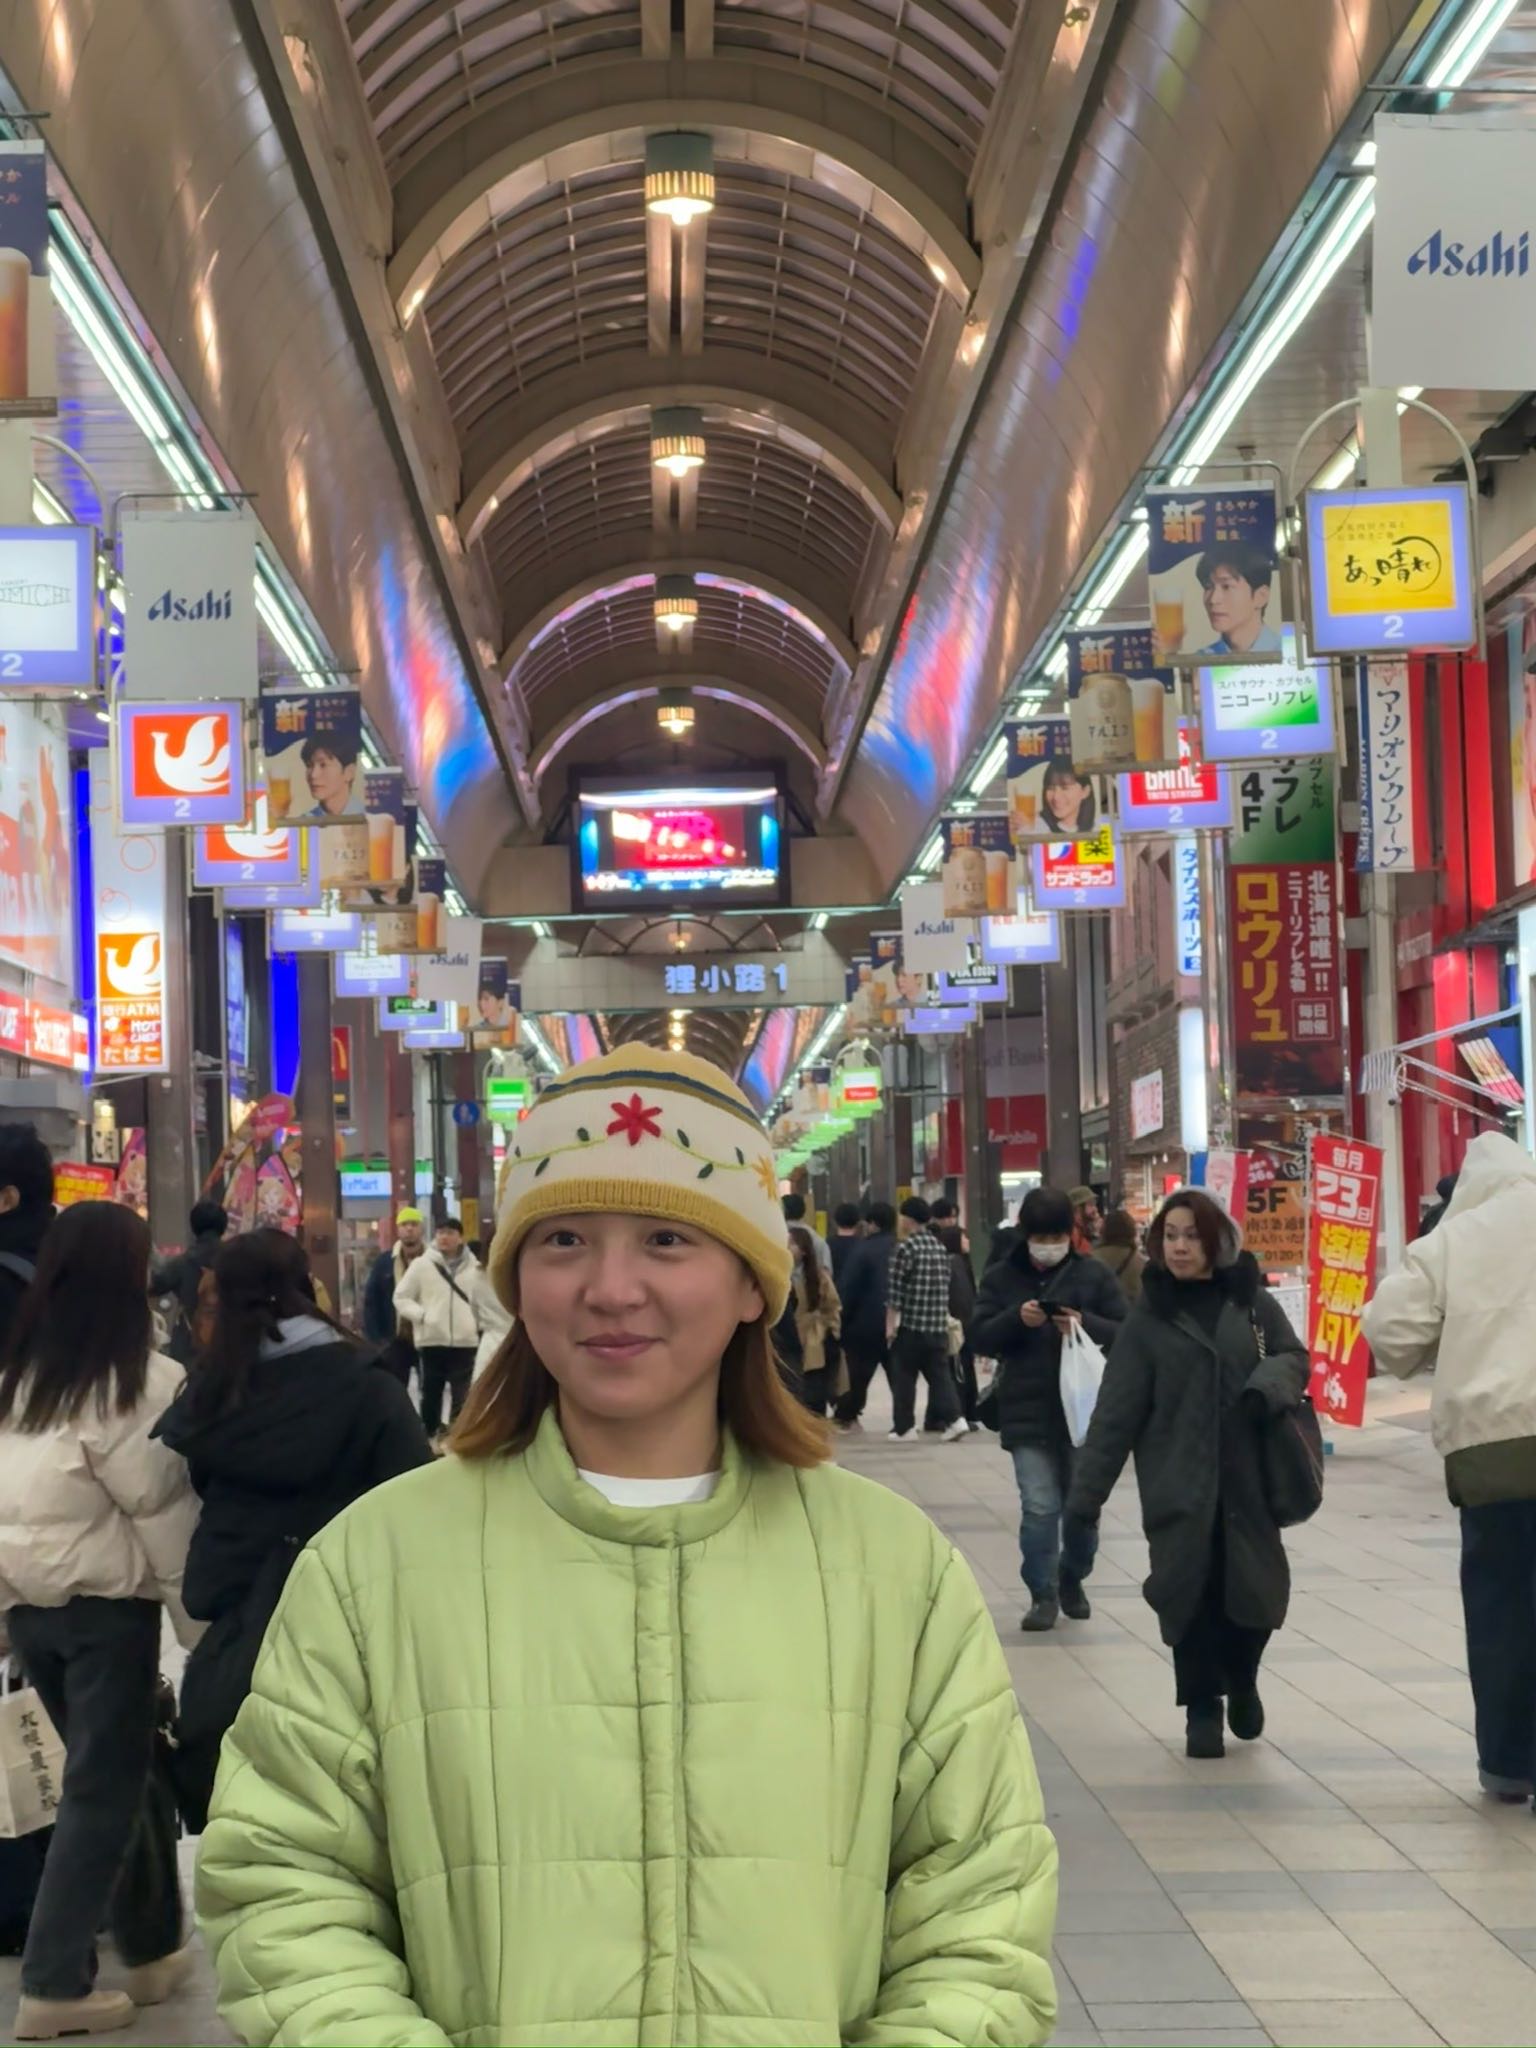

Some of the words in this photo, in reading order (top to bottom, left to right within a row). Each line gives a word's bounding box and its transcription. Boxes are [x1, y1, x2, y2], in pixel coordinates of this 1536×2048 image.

[1407, 229, 1531, 278] Asahi
[1162, 499, 1206, 543] 新
[147, 589, 232, 622] Asahi
[1383, 615, 1405, 640] 2
[1, 652, 24, 677] 2
[1079, 636, 1115, 672] 新
[1219, 690, 1313, 708] ニコーリフレ
[275, 698, 309, 733] 新
[1259, 729, 1280, 750] 2
[1376, 689, 1408, 867] マリオンクレープ
[173, 797, 191, 817] 2
[1168, 805, 1184, 824] 2
[240, 863, 255, 880] 2
[914, 919, 955, 936] Asahi
[1236, 872, 1288, 1041] ロウリュ
[103, 1045, 162, 1064] たばこ
[1333, 1146, 1364, 1172] 毎月
[1246, 1187, 1288, 1214] 5F
